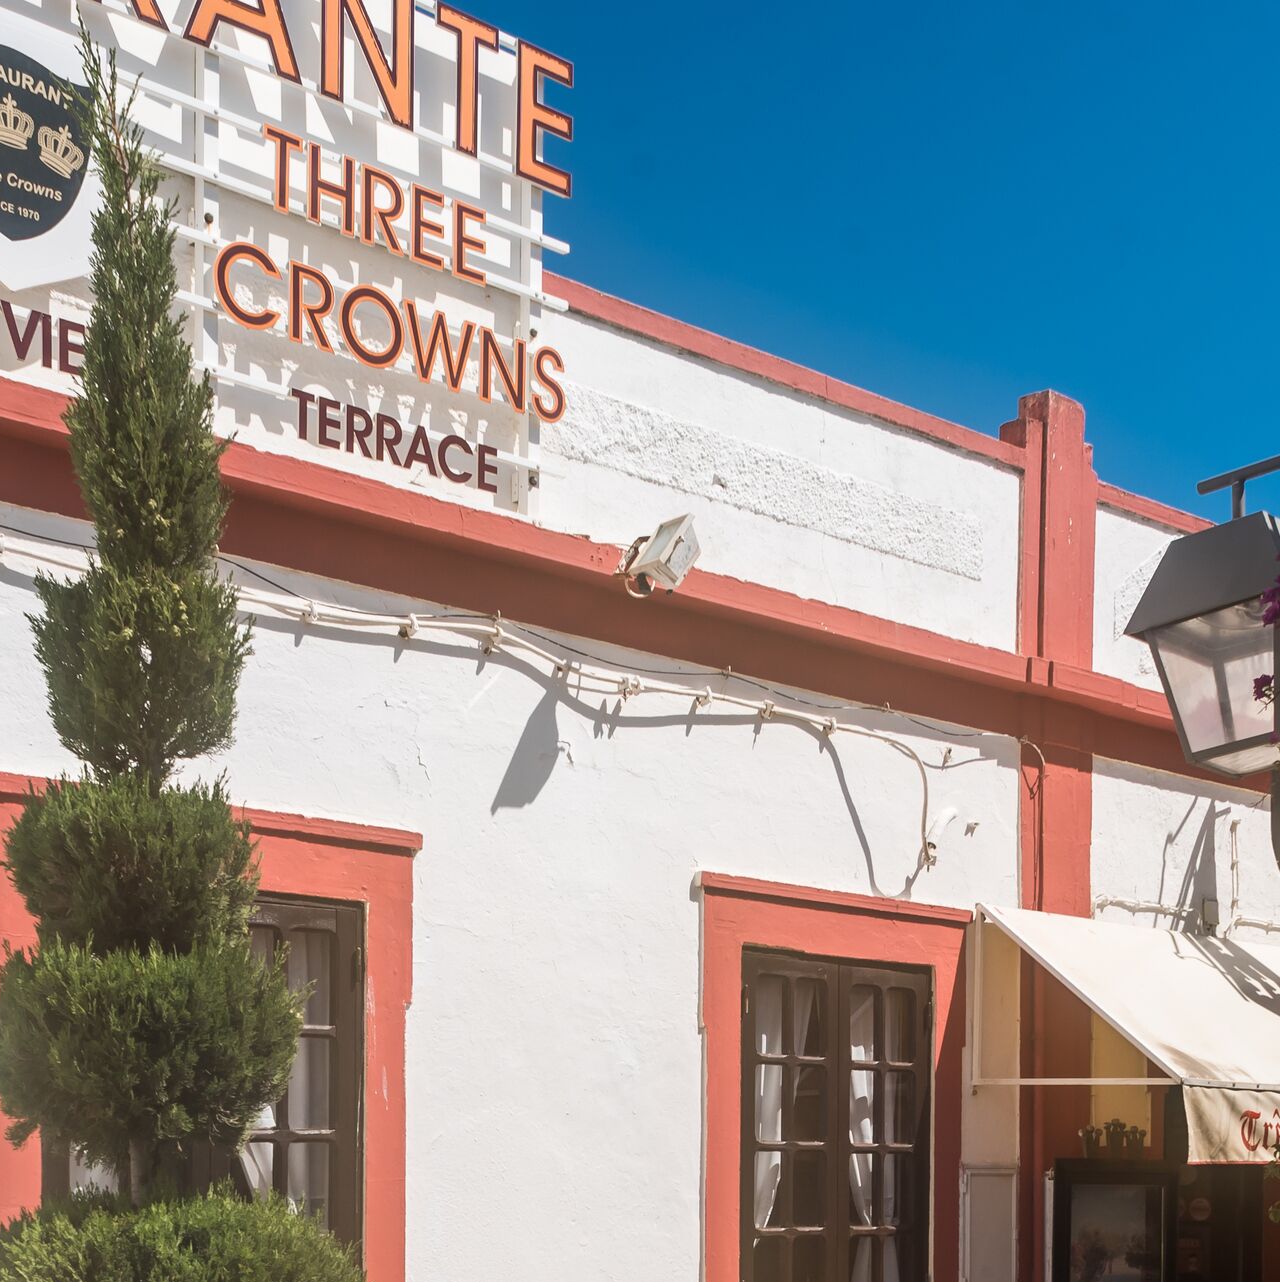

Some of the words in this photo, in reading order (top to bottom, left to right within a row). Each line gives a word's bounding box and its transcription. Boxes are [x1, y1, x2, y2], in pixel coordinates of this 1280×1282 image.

[85, 0, 573, 198] ANTE
[6, 172, 63, 202] Crowns
[17, 206, 40, 222] 1970
[263, 123, 486, 287] THREE
[0, 299, 88, 376] VIE
[213, 241, 566, 423] CROWNS
[291, 388, 498, 493] TERRACE
